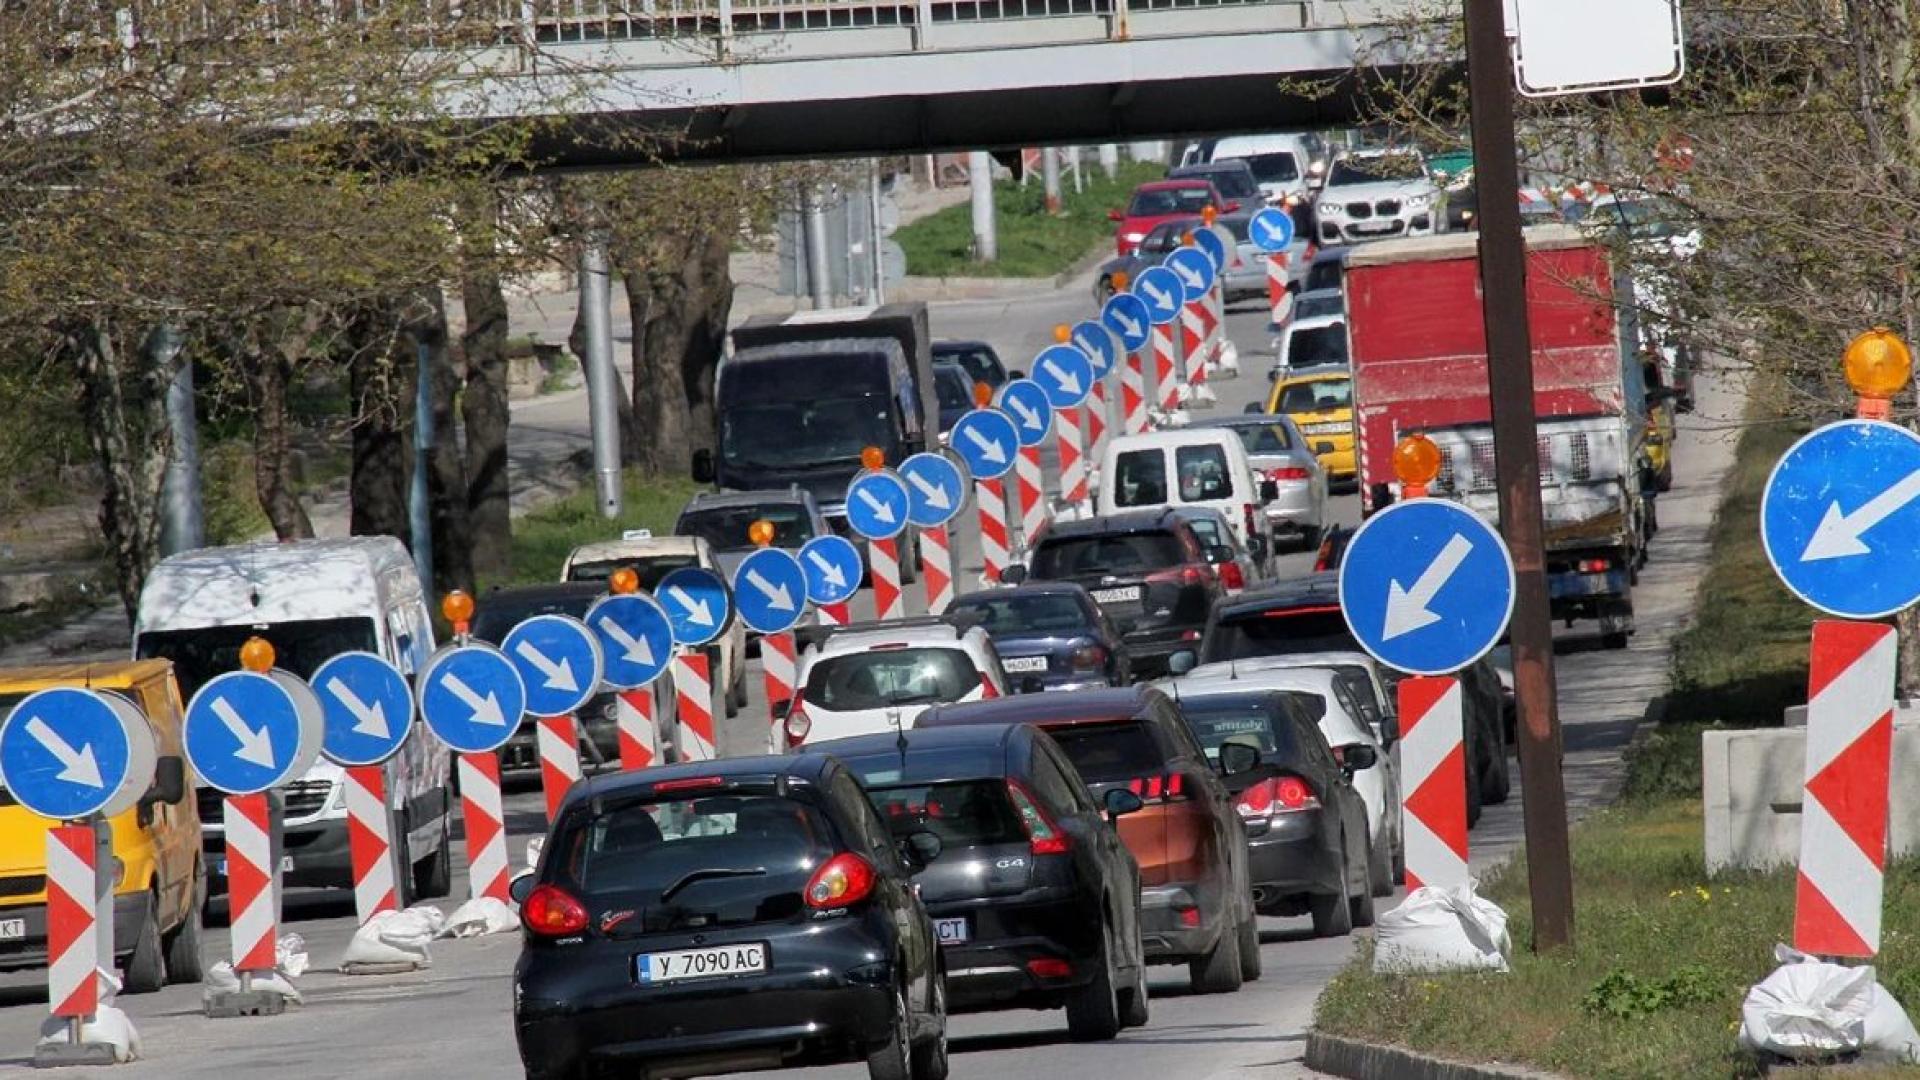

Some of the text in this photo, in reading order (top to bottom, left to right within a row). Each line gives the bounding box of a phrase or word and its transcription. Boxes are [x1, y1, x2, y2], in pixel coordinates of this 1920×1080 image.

[2, 921, 20, 936] KT
[659, 949, 761, 976] Y 7090 AC
